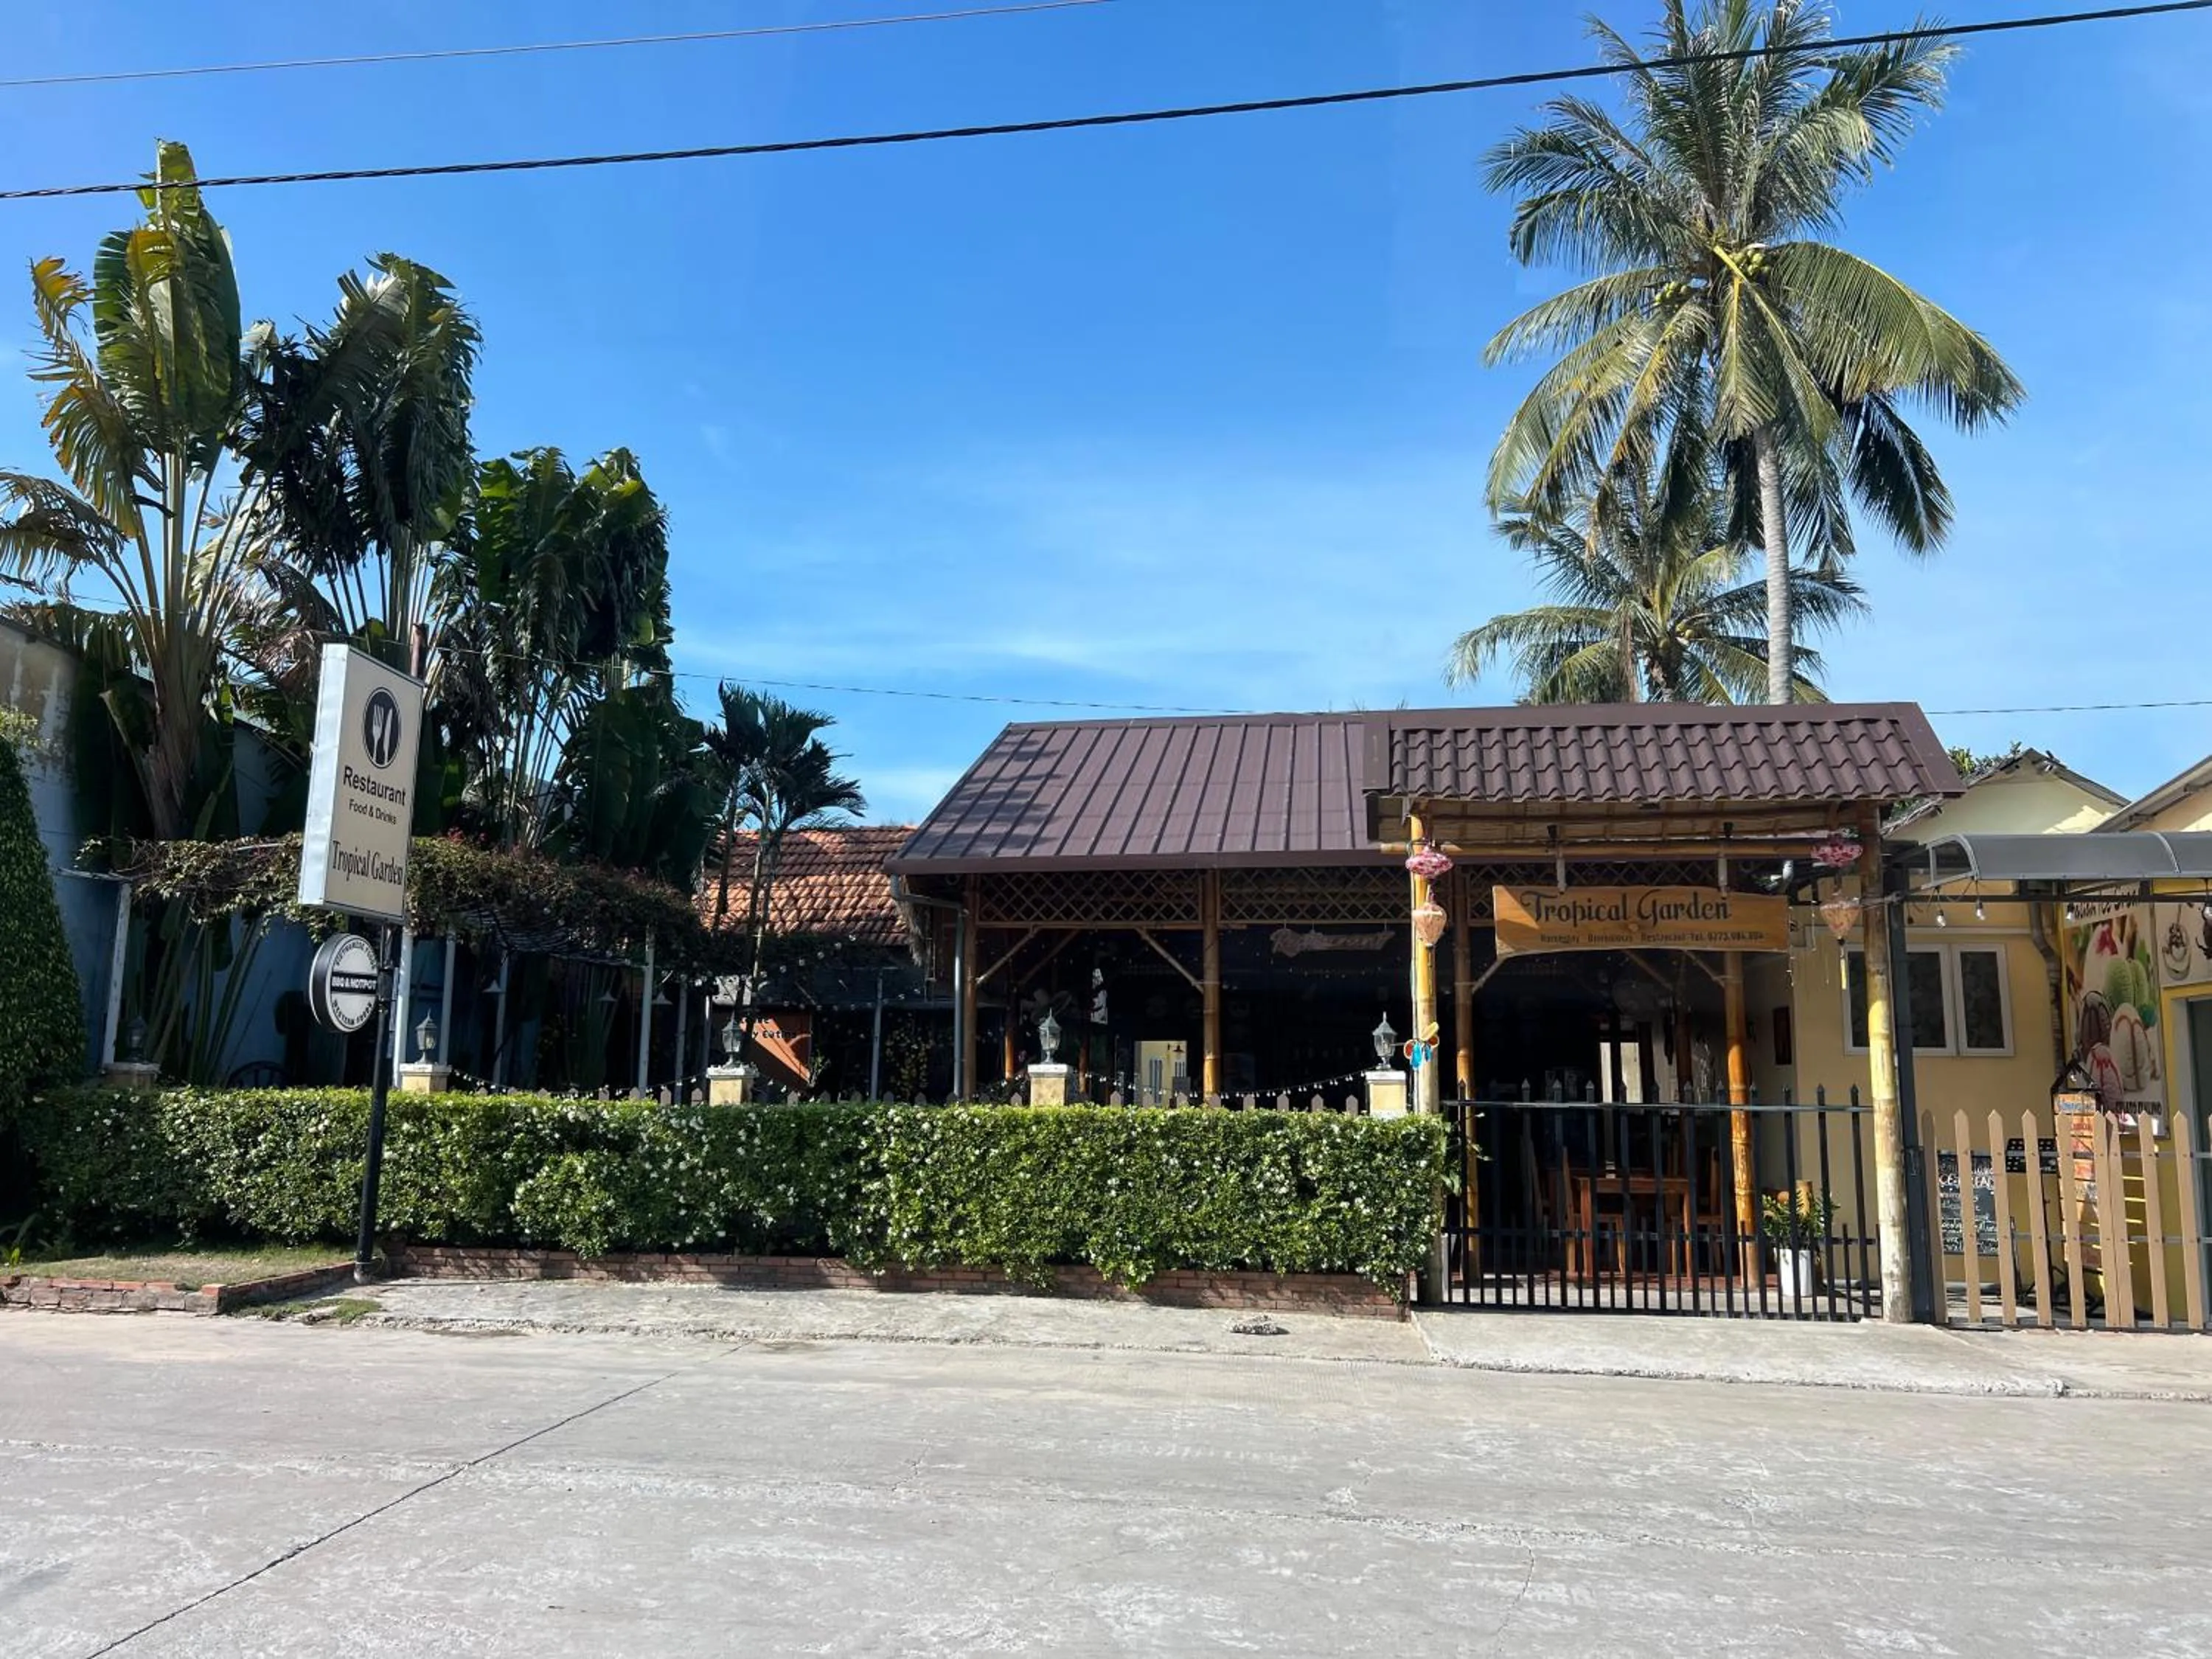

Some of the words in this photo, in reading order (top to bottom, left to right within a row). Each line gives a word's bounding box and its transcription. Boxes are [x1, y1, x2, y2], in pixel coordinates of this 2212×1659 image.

[343, 764, 406, 806] Restaurant
[349, 798, 368, 815] Food
[369, 804, 374, 818] &
[375, 807, 397, 825] Drinks
[333, 840, 370, 882] Tropical
[371, 852, 403, 885] Garden
[1520, 890, 1628, 928] Tropical
[1636, 888, 1733, 928] Garden
[350, 978, 377, 990] HOTPOT
